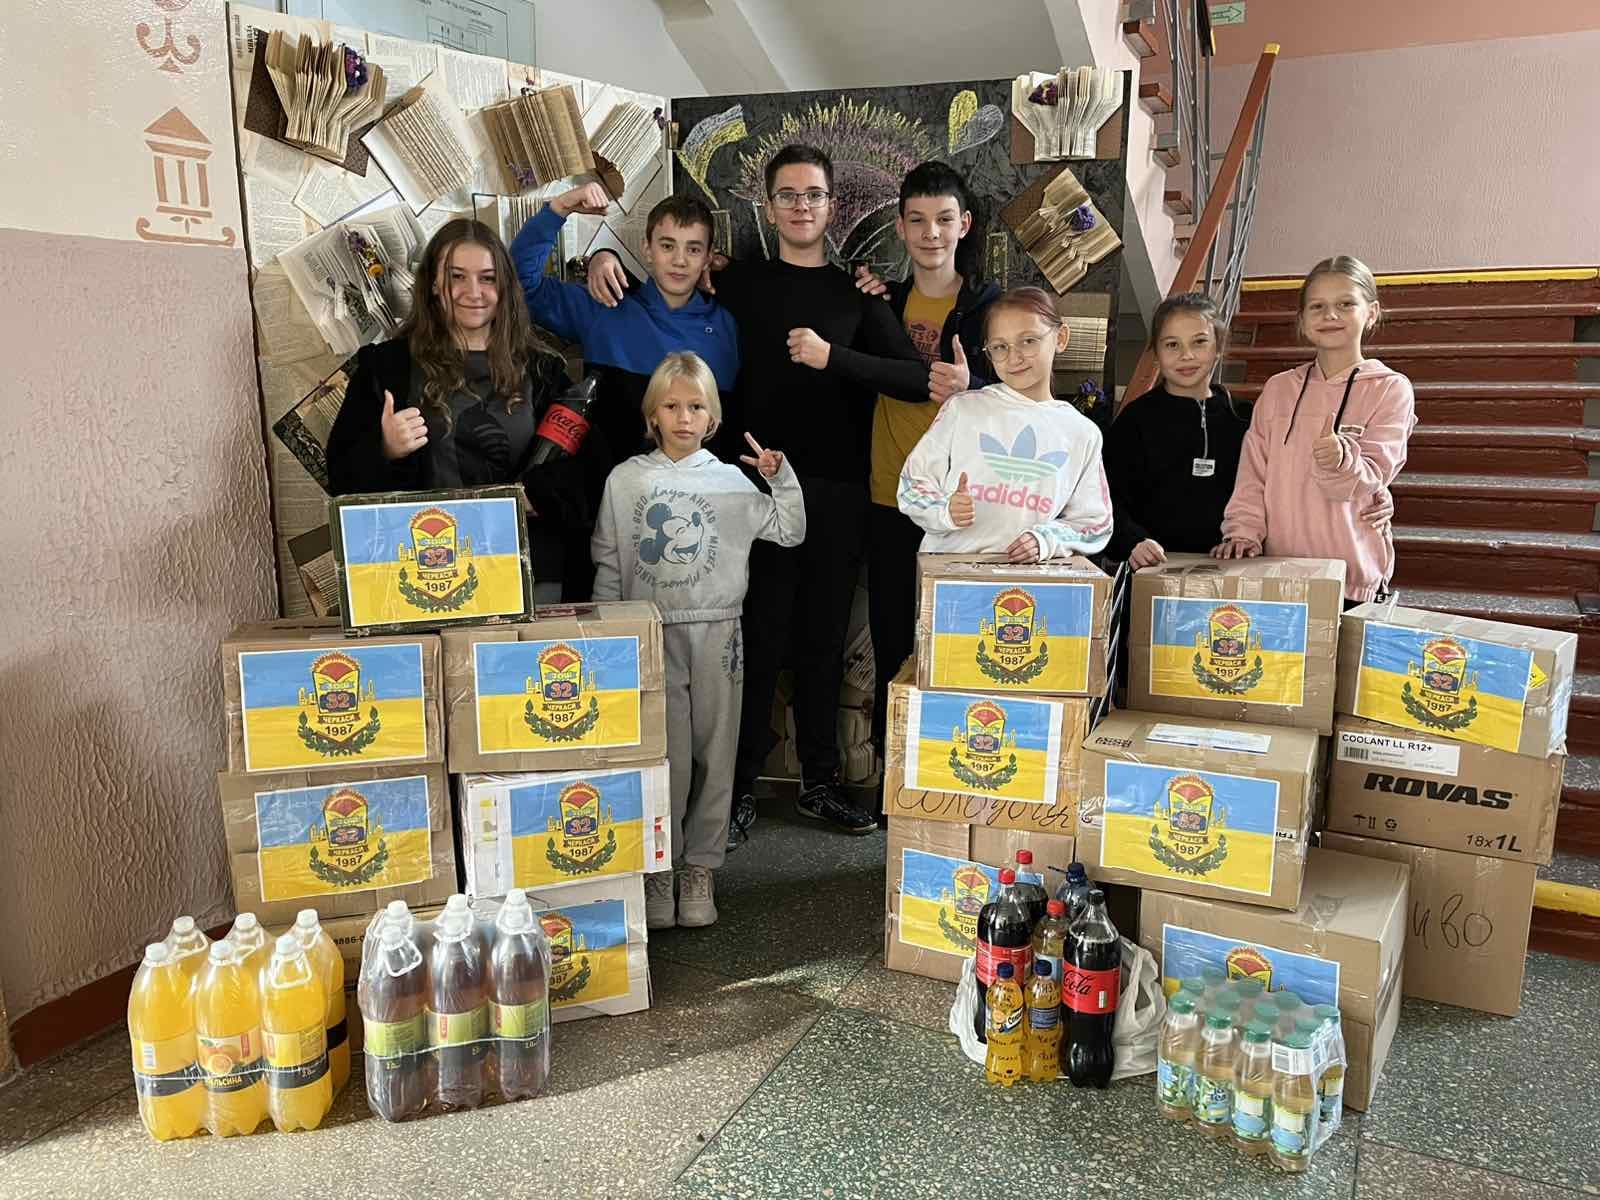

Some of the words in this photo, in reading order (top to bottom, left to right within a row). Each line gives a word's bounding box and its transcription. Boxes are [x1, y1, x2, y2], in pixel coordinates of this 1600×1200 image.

[970, 483, 1052, 513] adidas
[425, 548, 448, 566] 32
[425, 580, 452, 592] 1987
[1002, 625, 1024, 641] 32
[1217, 639, 1239, 655] 32
[1000, 655, 1025, 665] 1987
[1215, 667, 1240, 677] 1987
[1430, 672, 1453, 690] 32
[550, 682, 572, 698] 32
[326, 693, 350, 710] 32
[547, 703, 576, 712] ЧЕРКАСИ
[1425, 699, 1452, 712] 1987
[323, 715, 354, 724] ЧЕРКАСИ
[550, 711, 575, 723] 1987
[326, 724, 353, 736] 1987
[974, 735, 994, 751] 32
[1342, 734, 1390, 747] COOLANT
[1393, 740, 1405, 749] LL
[1408, 742, 1432, 752] R12+
[971, 761, 994, 772] 1987
[1363, 773, 1513, 810] ROVAS
[570, 817, 591, 835] 32
[569, 846, 594, 857] 1987
[1174, 842, 1201, 855] 1987
[336, 854, 363, 867] 1987
[960, 924, 976, 934] 198
[549, 972, 568, 985] 987
